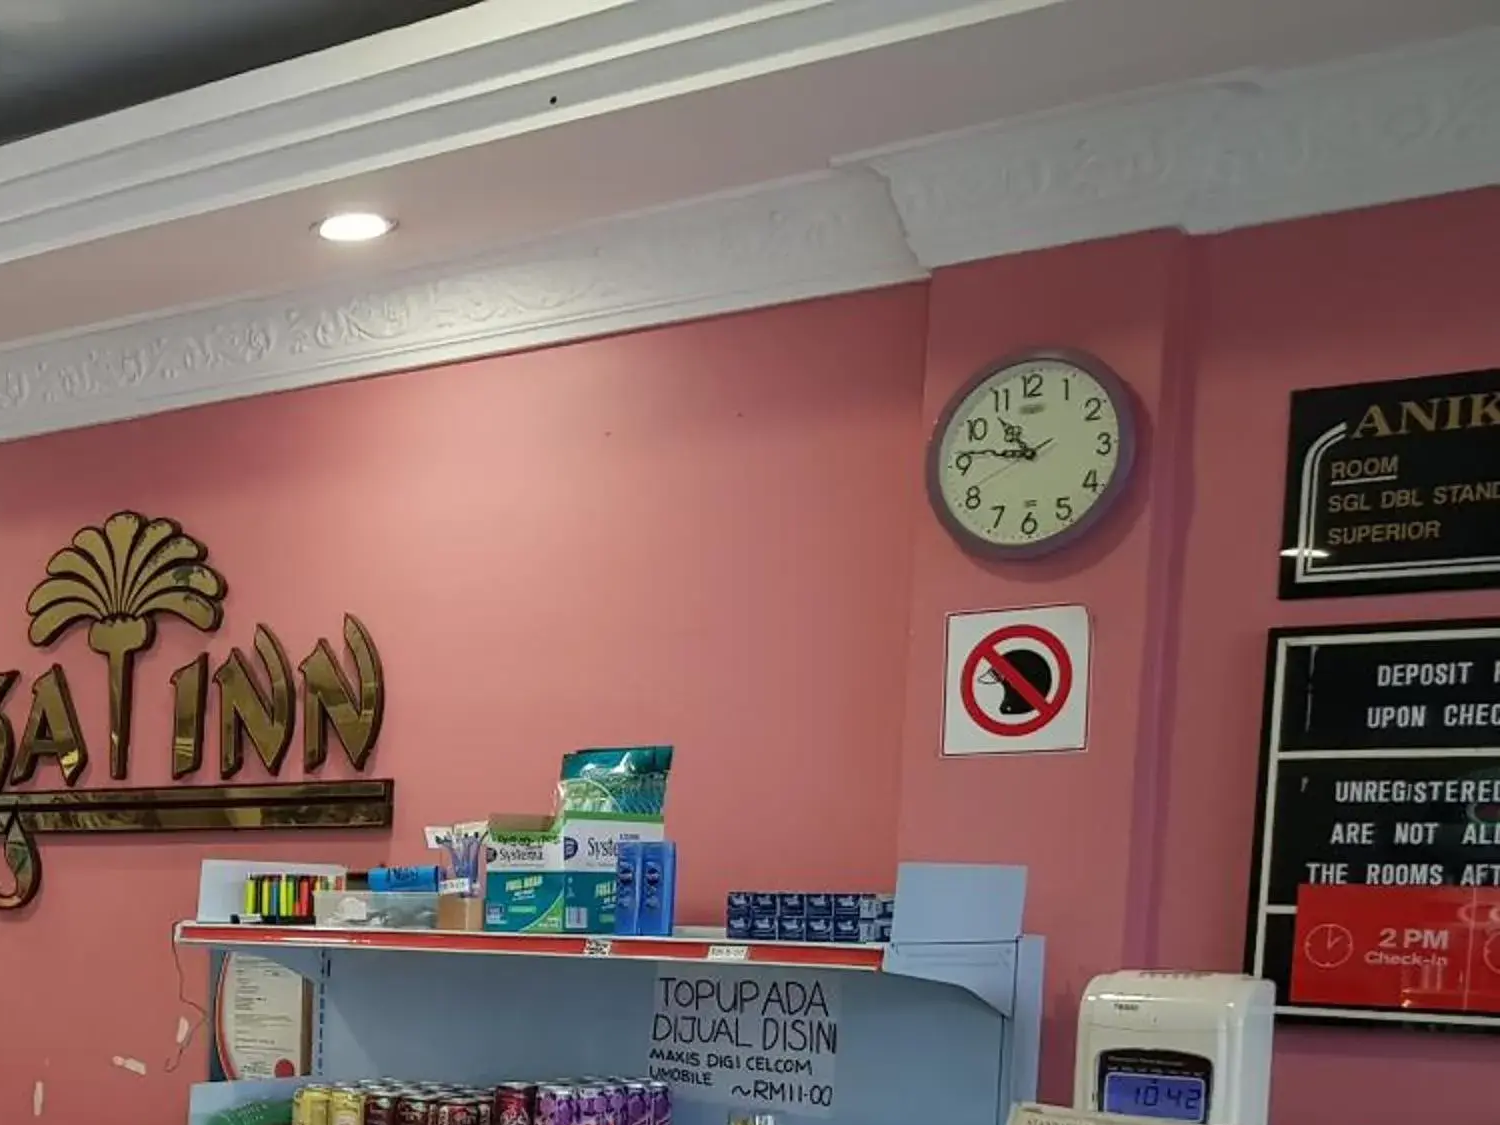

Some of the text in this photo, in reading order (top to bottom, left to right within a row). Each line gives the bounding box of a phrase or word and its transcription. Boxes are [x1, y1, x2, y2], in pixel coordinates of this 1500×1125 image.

[1021, 373, 1044, 399] 12
[1062, 377, 1070, 401] 1
[990, 387, 1010, 413] 11
[1084, 397, 1102, 422] 2
[1352, 391, 1500, 439] ANIK
[966, 417, 988, 443] 10
[1096, 431, 1112, 456] 3
[955, 452, 973, 477] 9
[1331, 455, 1399, 479] ROOM
[1082, 469, 1099, 493] 4
[964, 485, 982, 510] 8
[1055, 496, 1073, 521] 5
[1328, 494, 1372, 513] SGL
[1380, 488, 1424, 509] DBL
[990, 505, 1006, 529] 7
[1020, 511, 1039, 536] 6
[1328, 519, 1442, 545] SUPERIOR
[1376, 660, 1474, 687] DEPOSIT
[171, 611, 385, 780] INN
[1366, 703, 1500, 729] UPON CHEC
[1329, 821, 1376, 845] ARE
[1393, 821, 1441, 845] NOT
[1305, 862, 1350, 885] THE
[1365, 863, 1444, 886] ROOMS
[1378, 928, 1450, 950] 2 PM
[1363, 950, 1449, 966] Check-in
[652, 1013, 838, 1054] DIJUAL DISINI
[650, 1048, 813, 1076] MAXIS DIGI CELCOM
